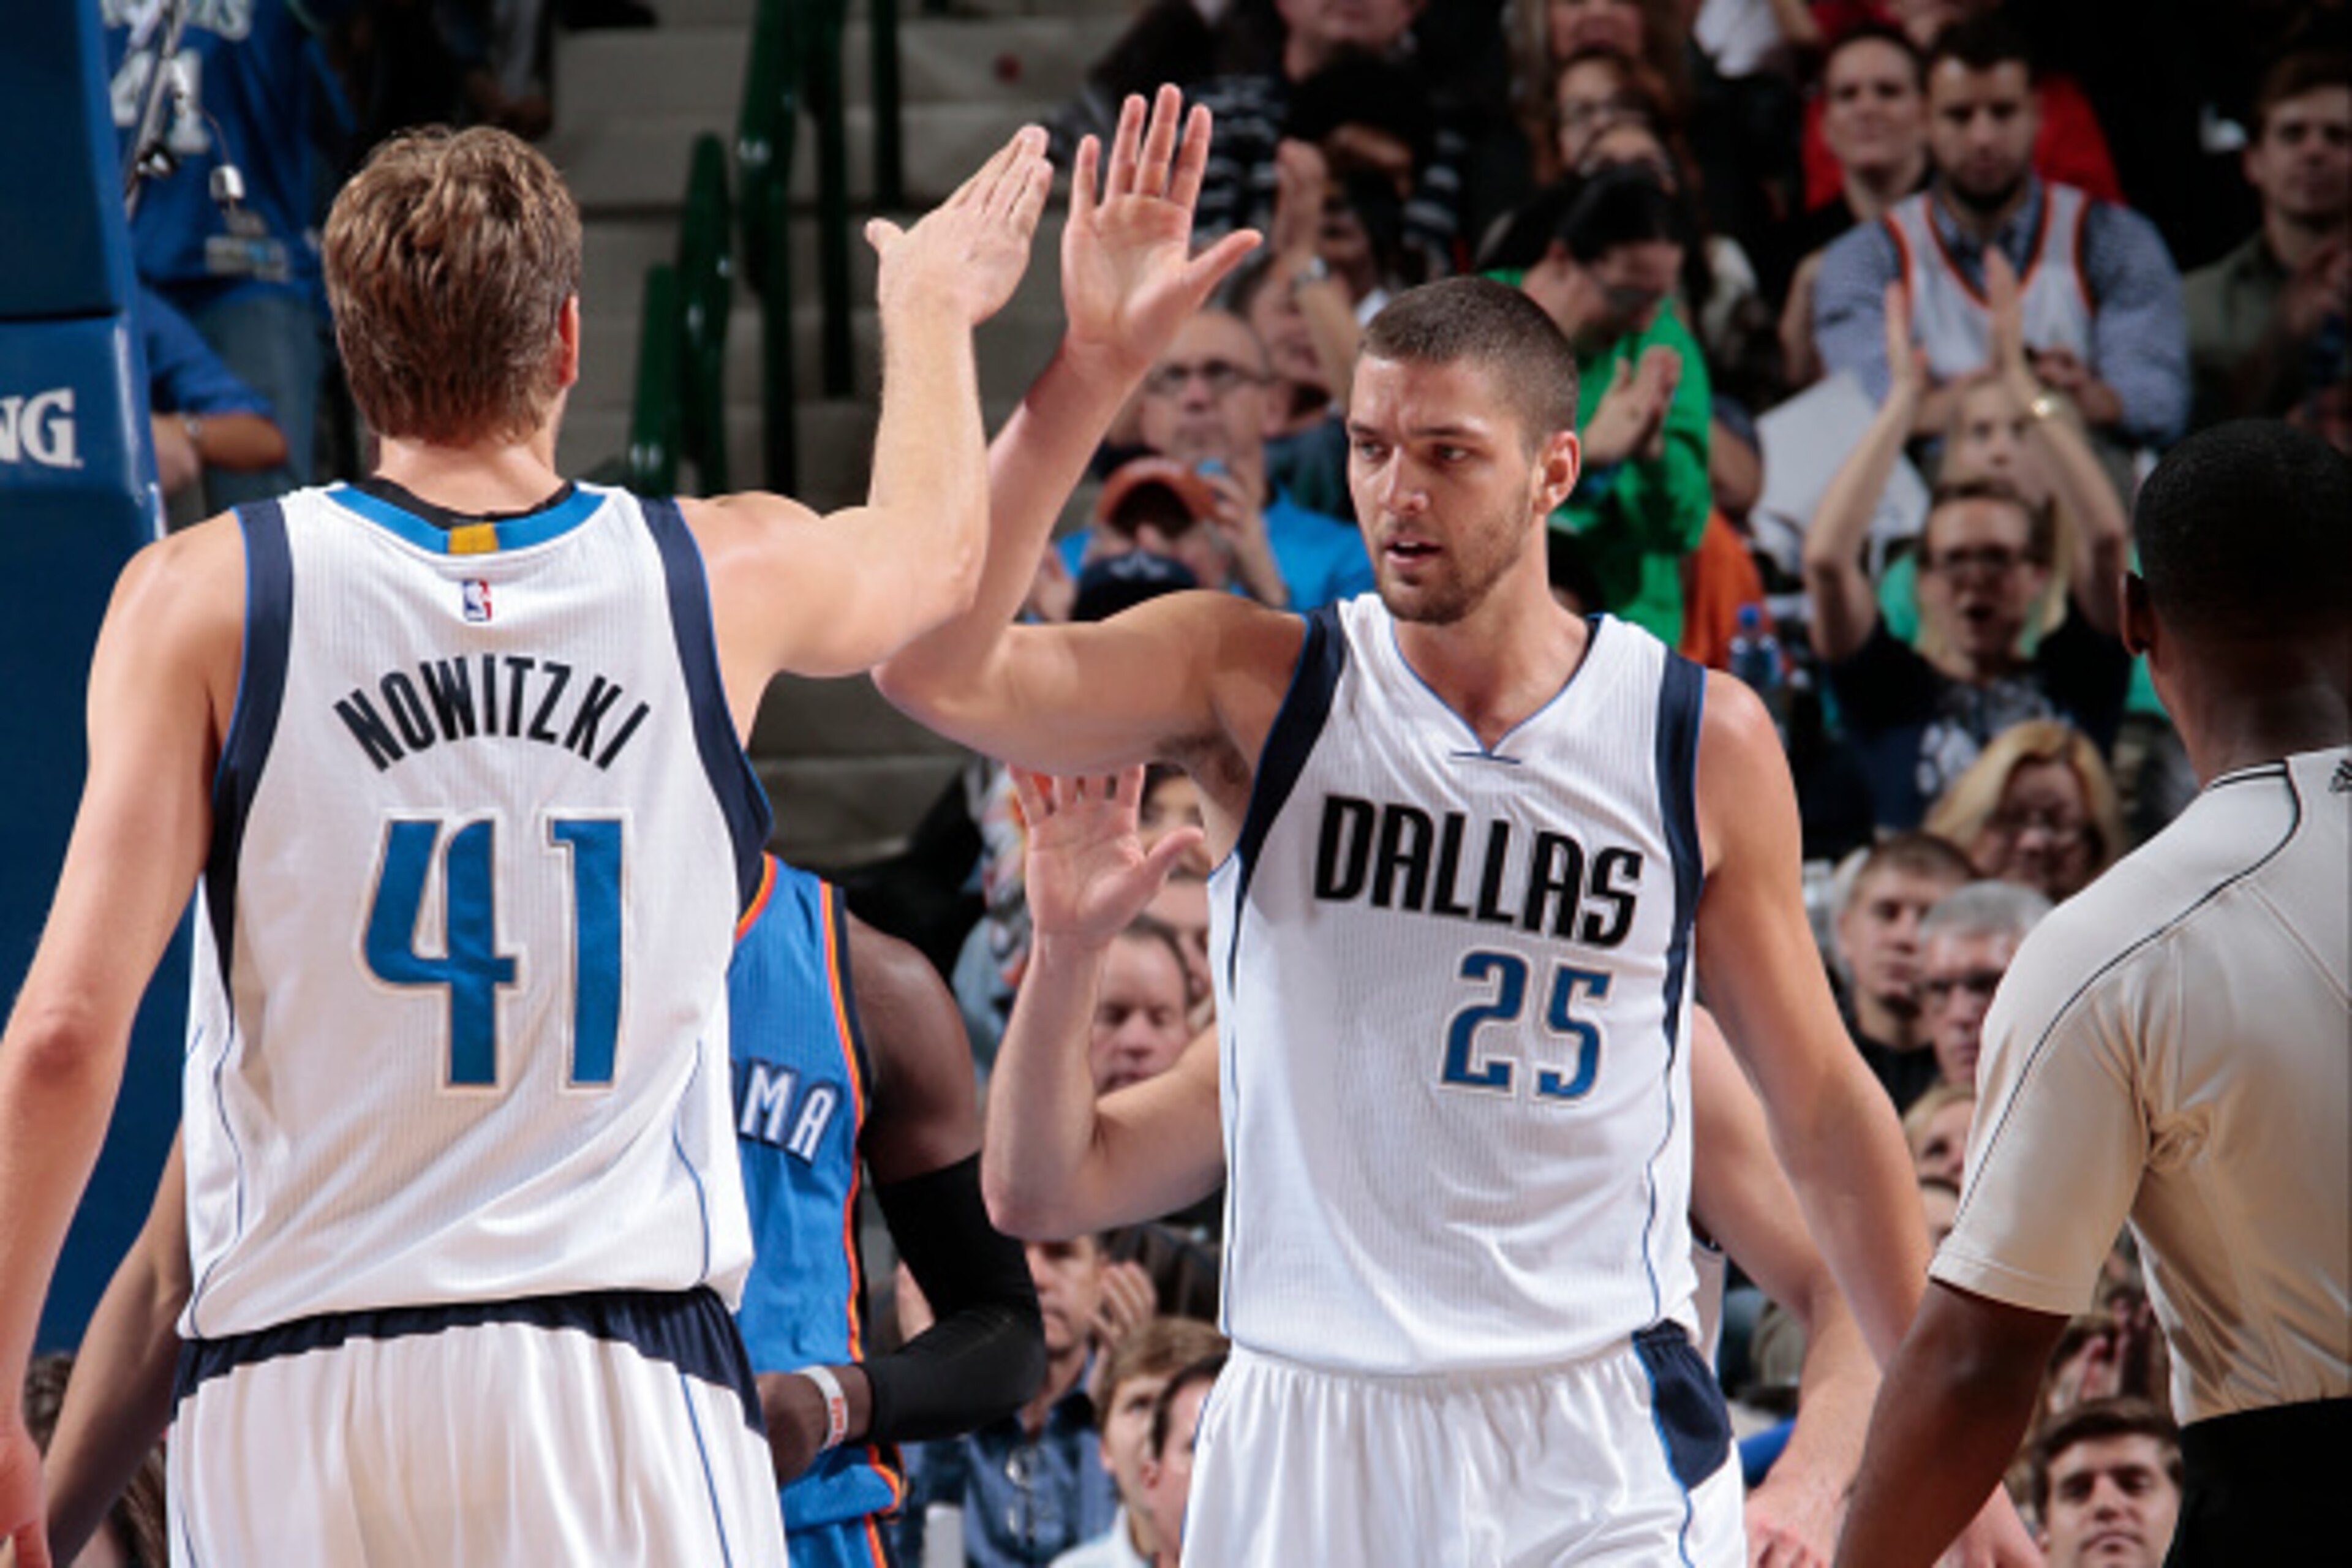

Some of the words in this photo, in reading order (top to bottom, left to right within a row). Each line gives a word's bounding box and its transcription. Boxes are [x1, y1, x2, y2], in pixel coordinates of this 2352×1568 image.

[333, 653, 650, 772] NOWITZKI
[1314, 794, 1644, 948] DALLAS
[360, 812, 628, 1090] 41
[1439, 949, 1613, 1101] 25
[731, 1056, 844, 1169] MA
